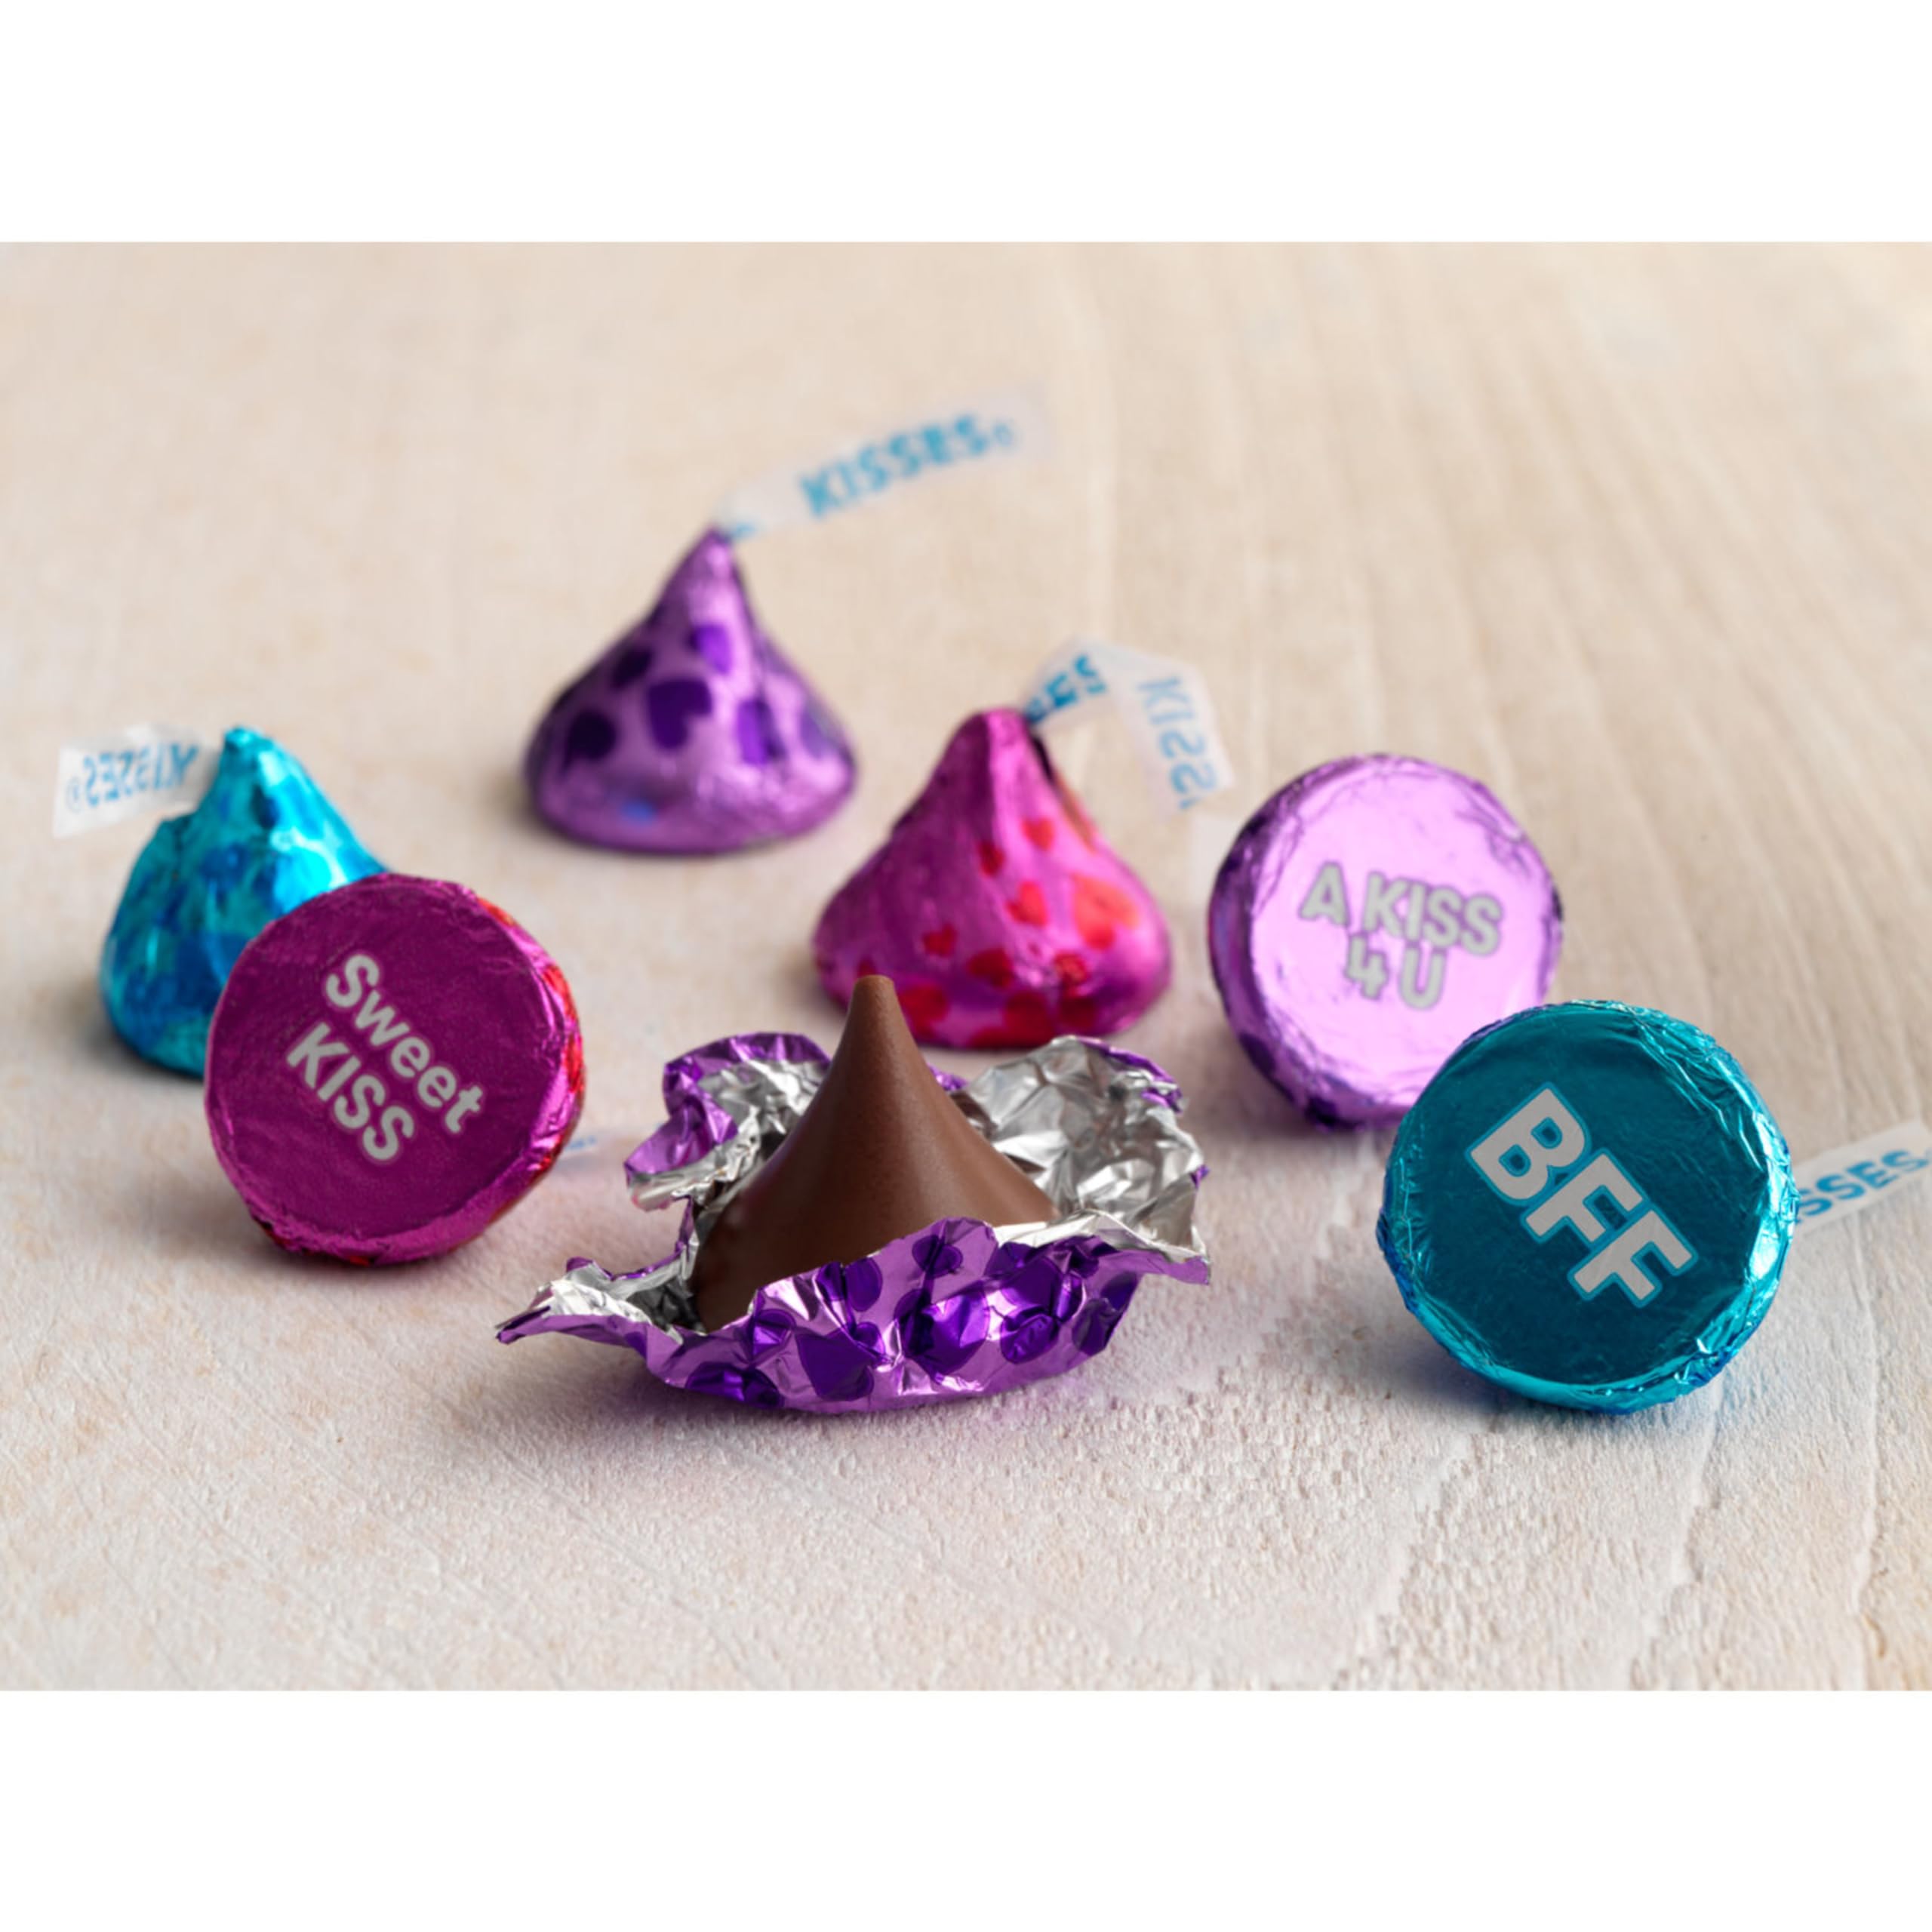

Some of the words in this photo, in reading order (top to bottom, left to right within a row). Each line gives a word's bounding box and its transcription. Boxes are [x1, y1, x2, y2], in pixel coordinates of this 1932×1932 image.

[1298, 862, 1350, 928] A
[1361, 870, 1503, 957] KISS
[1344, 932, 1389, 1000] 4
[1399, 943, 1447, 1010] U
[286, 1022, 415, 1161] KISS
[325, 953, 484, 1133] Sweet
[1465, 1081, 1699, 1308] BFF
[1795, 1149, 1929, 1224] SSES
